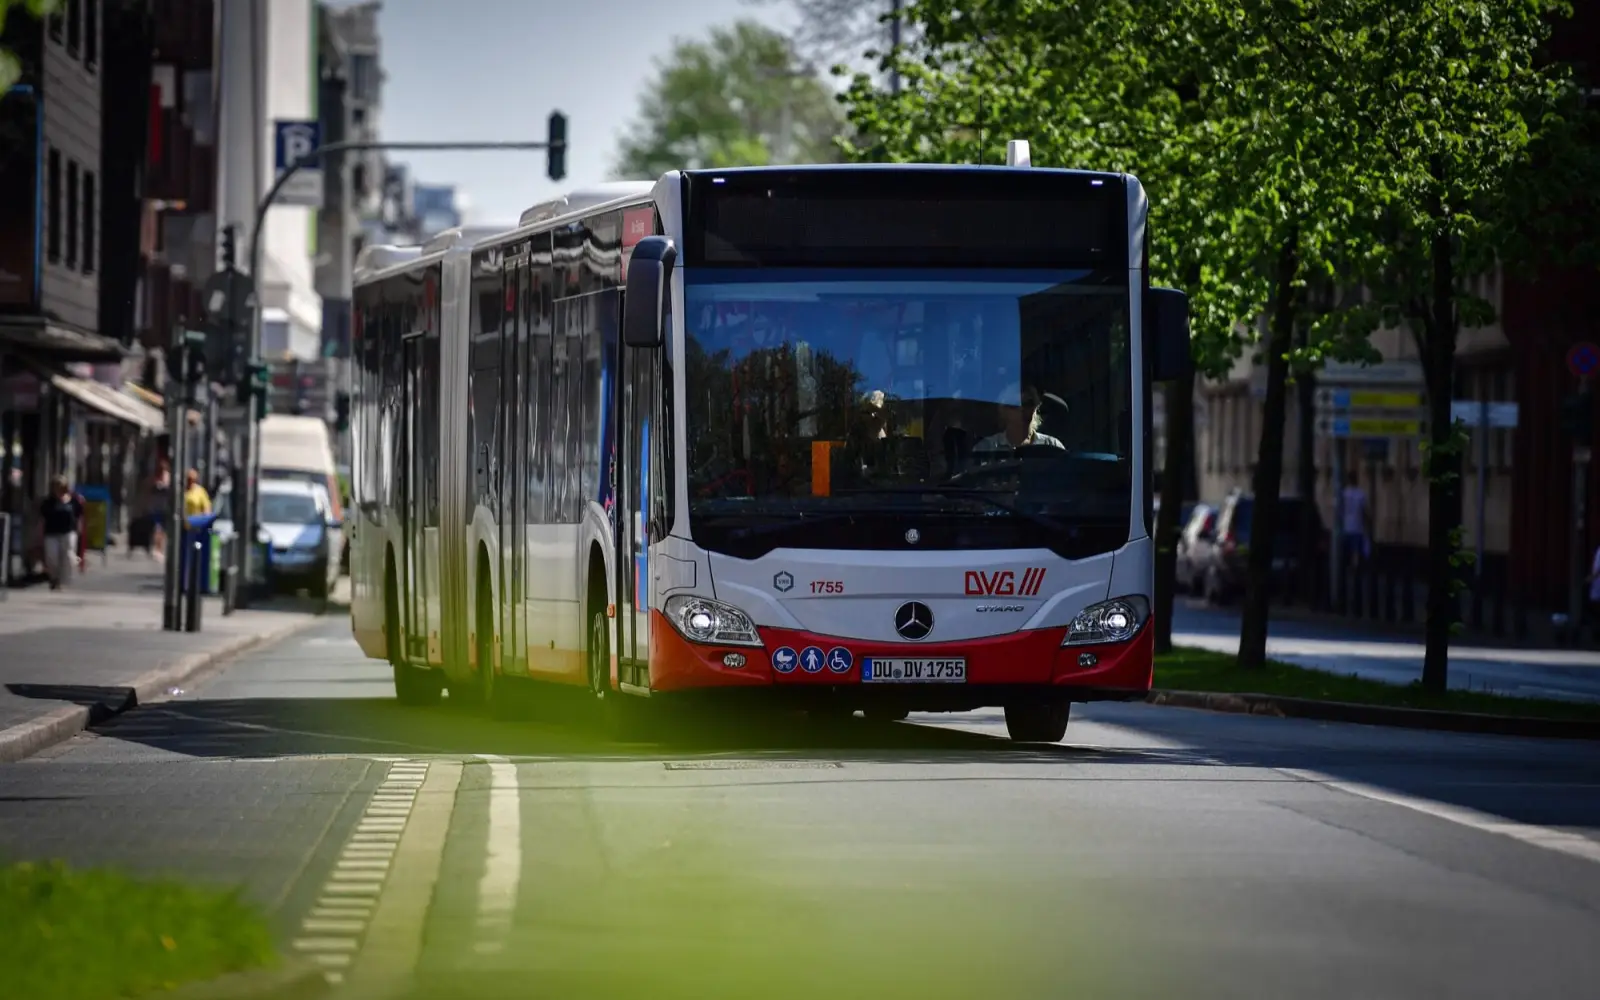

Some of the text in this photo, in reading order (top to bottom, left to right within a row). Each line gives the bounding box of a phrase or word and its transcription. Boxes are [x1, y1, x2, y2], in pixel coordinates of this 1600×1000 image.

[810, 581, 844, 594] 1755
[965, 571, 1014, 595] DVG
[976, 604, 1025, 613] CITARO
[873, 661, 892, 678] DU
[926, 661, 964, 678] 1755
